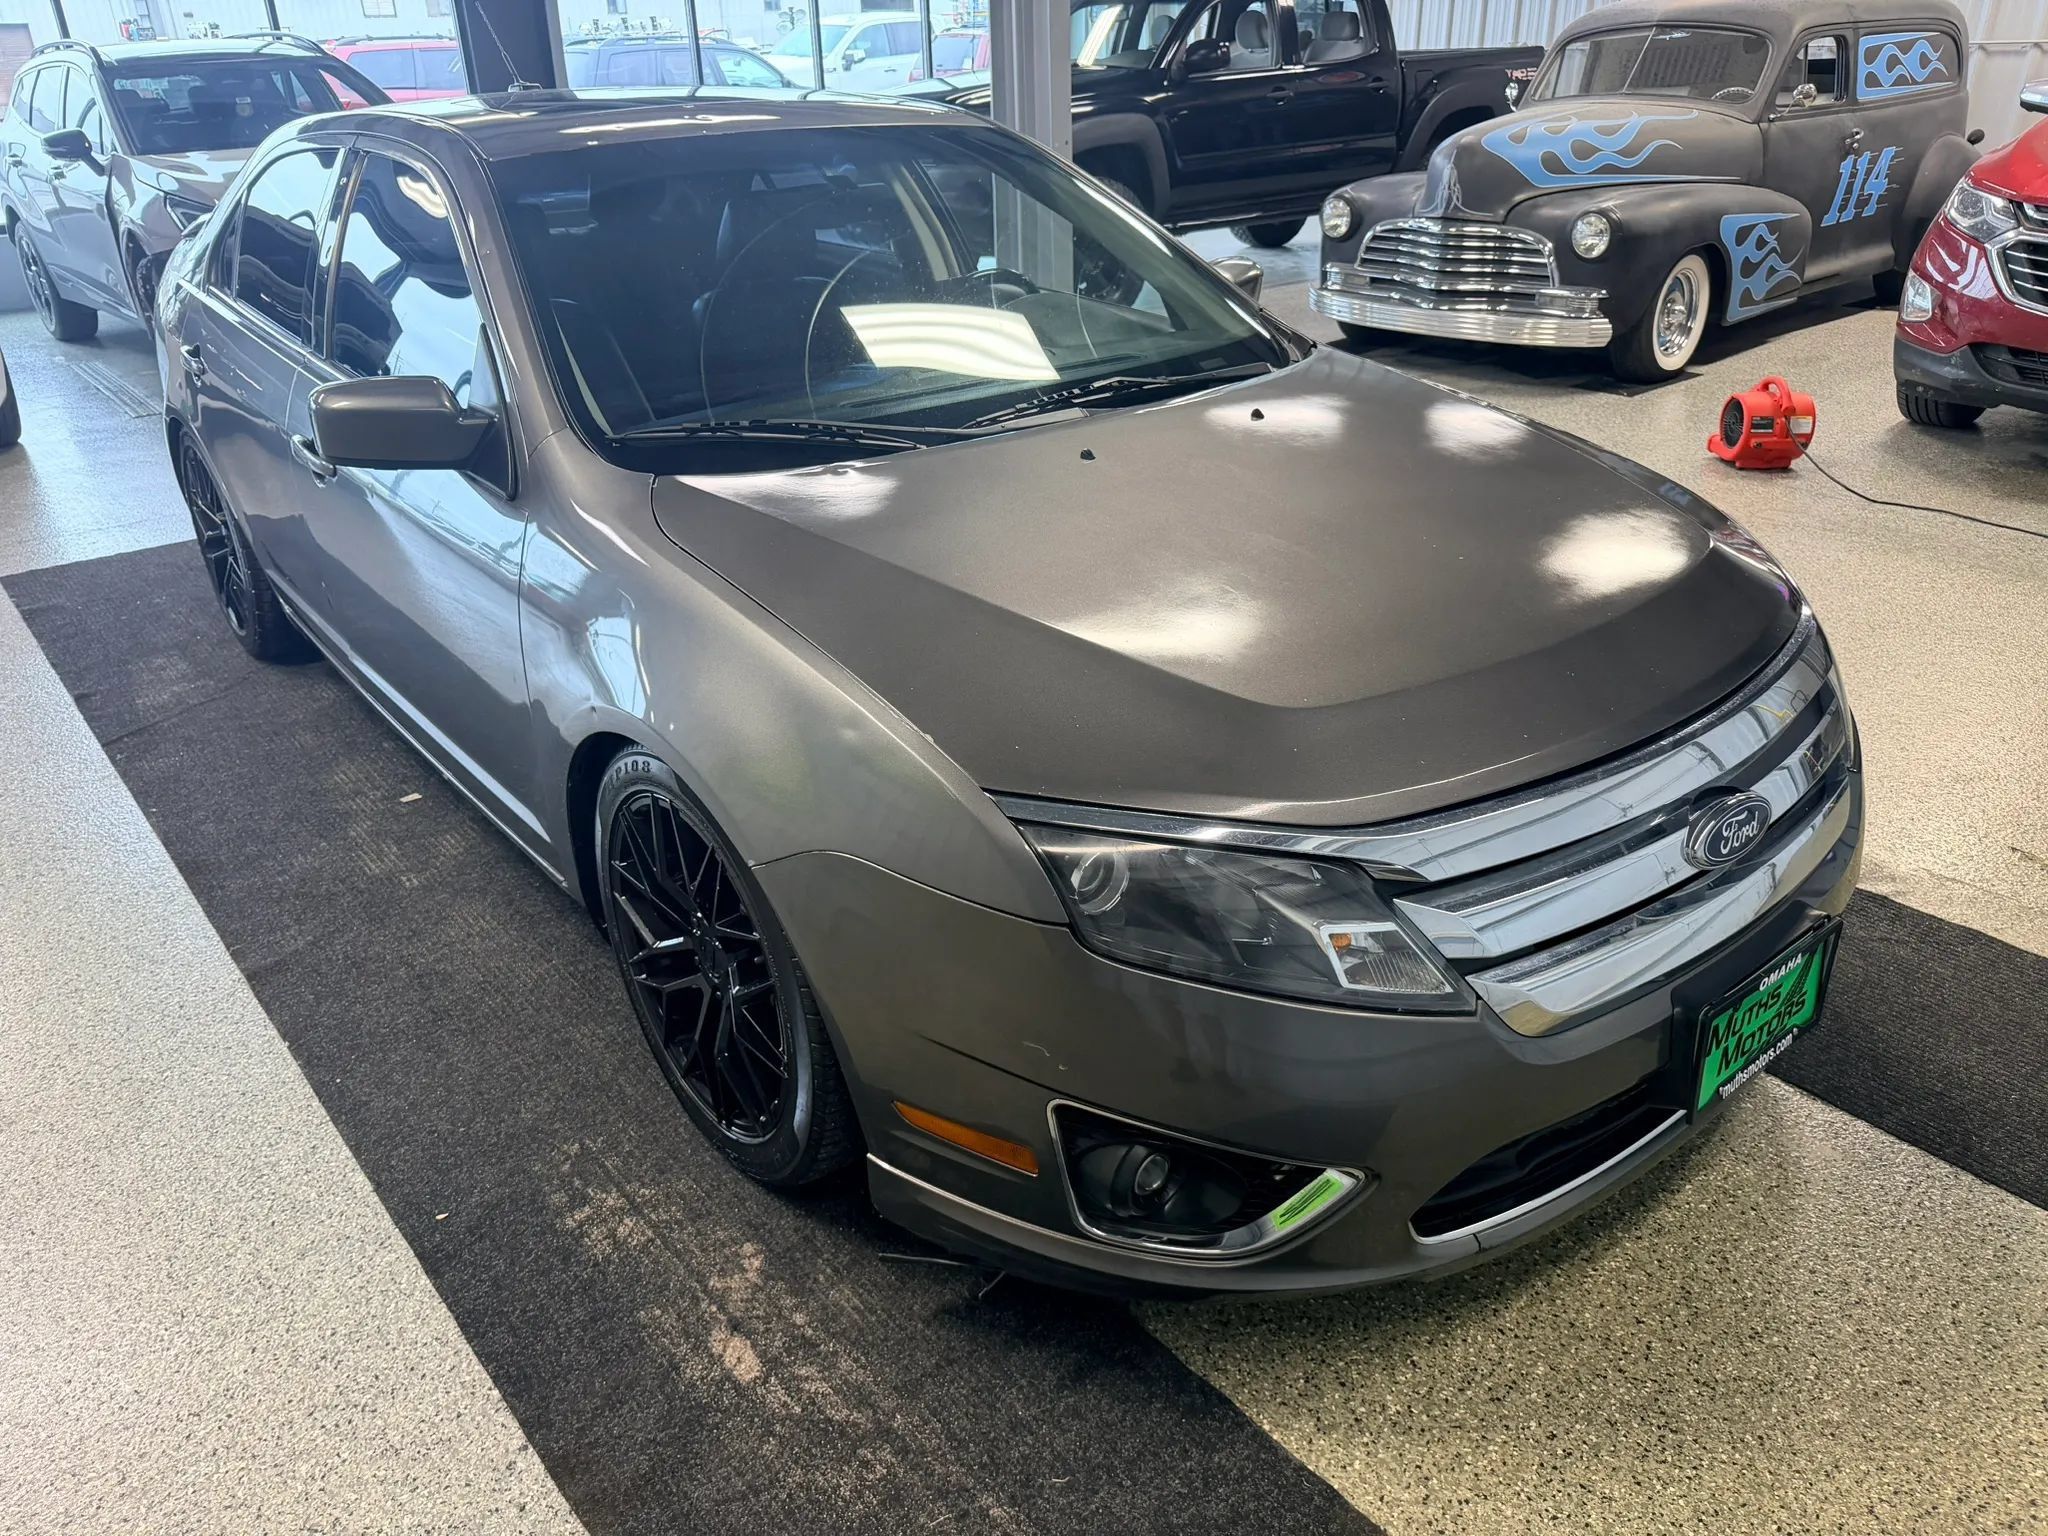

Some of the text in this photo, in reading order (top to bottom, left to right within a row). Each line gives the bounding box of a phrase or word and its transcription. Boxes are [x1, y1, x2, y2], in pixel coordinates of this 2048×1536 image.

[1820, 146, 1896, 227] 114
[1720, 811, 1759, 855] Ford
[1759, 953, 1802, 991] OMAHA
[1706, 983, 1783, 1058] MUTHS
[1716, 990, 1808, 1077] MOTORS
[1722, 1033, 1793, 1099] muthsmotors.com
